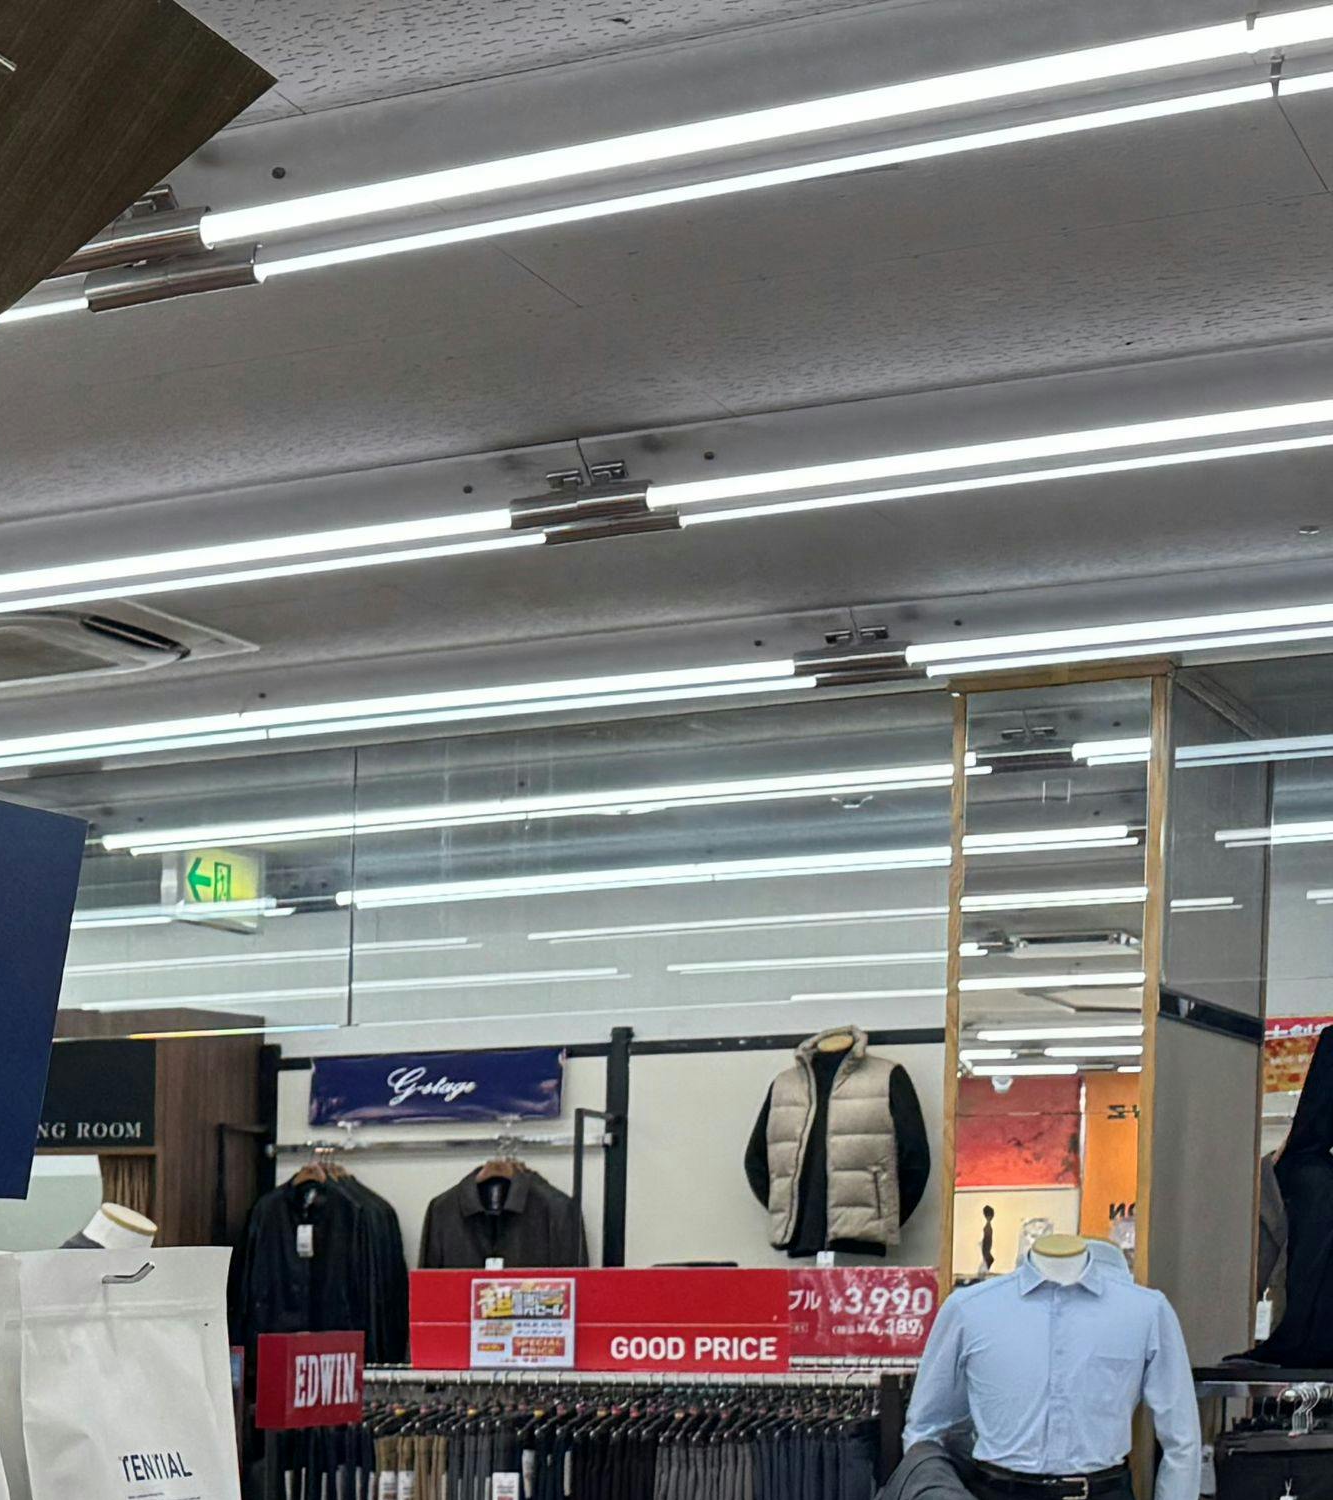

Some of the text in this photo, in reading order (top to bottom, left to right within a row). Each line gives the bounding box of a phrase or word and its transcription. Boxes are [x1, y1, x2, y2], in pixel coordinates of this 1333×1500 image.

[77, 1121, 143, 1140] ROOM
[610, 1335, 778, 1361] GOOD PRICE
[293, 1352, 357, 1409] EDWIN
[121, 1451, 193, 1482] TENTIAL
